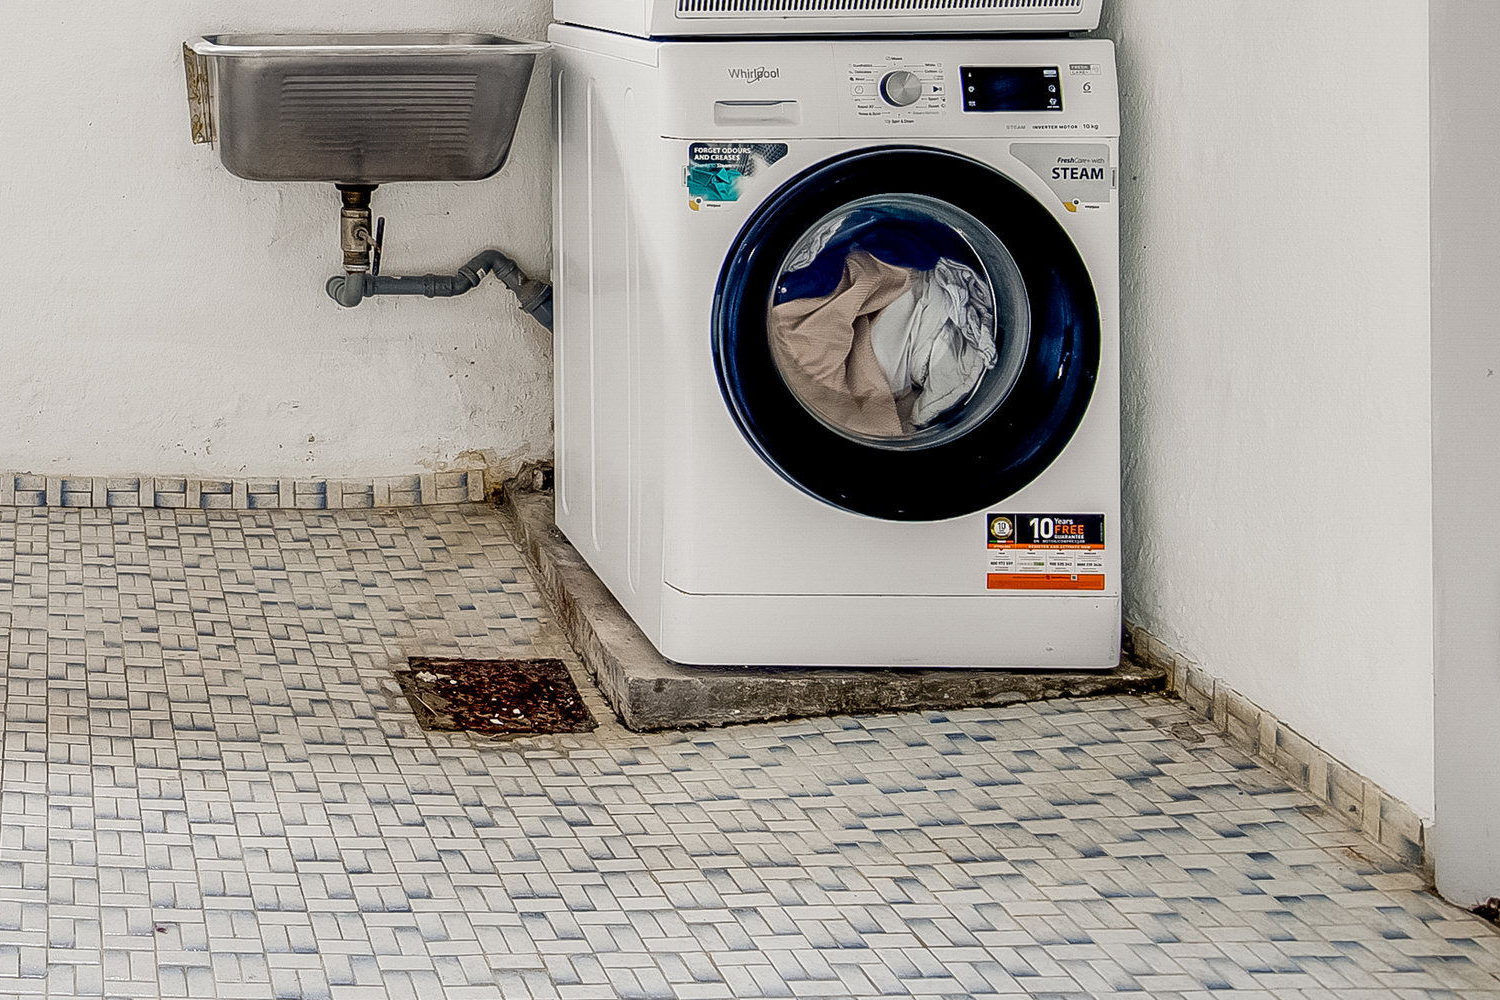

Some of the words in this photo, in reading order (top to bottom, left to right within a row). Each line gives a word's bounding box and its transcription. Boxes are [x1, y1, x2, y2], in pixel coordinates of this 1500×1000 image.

[728, 67, 780, 83] Whirlpool
[1051, 167, 1104, 180] STEAM
[997, 522, 1006, 530] 10
[1029, 517, 1054, 539] 10
[1054, 524, 1085, 534] FREE
